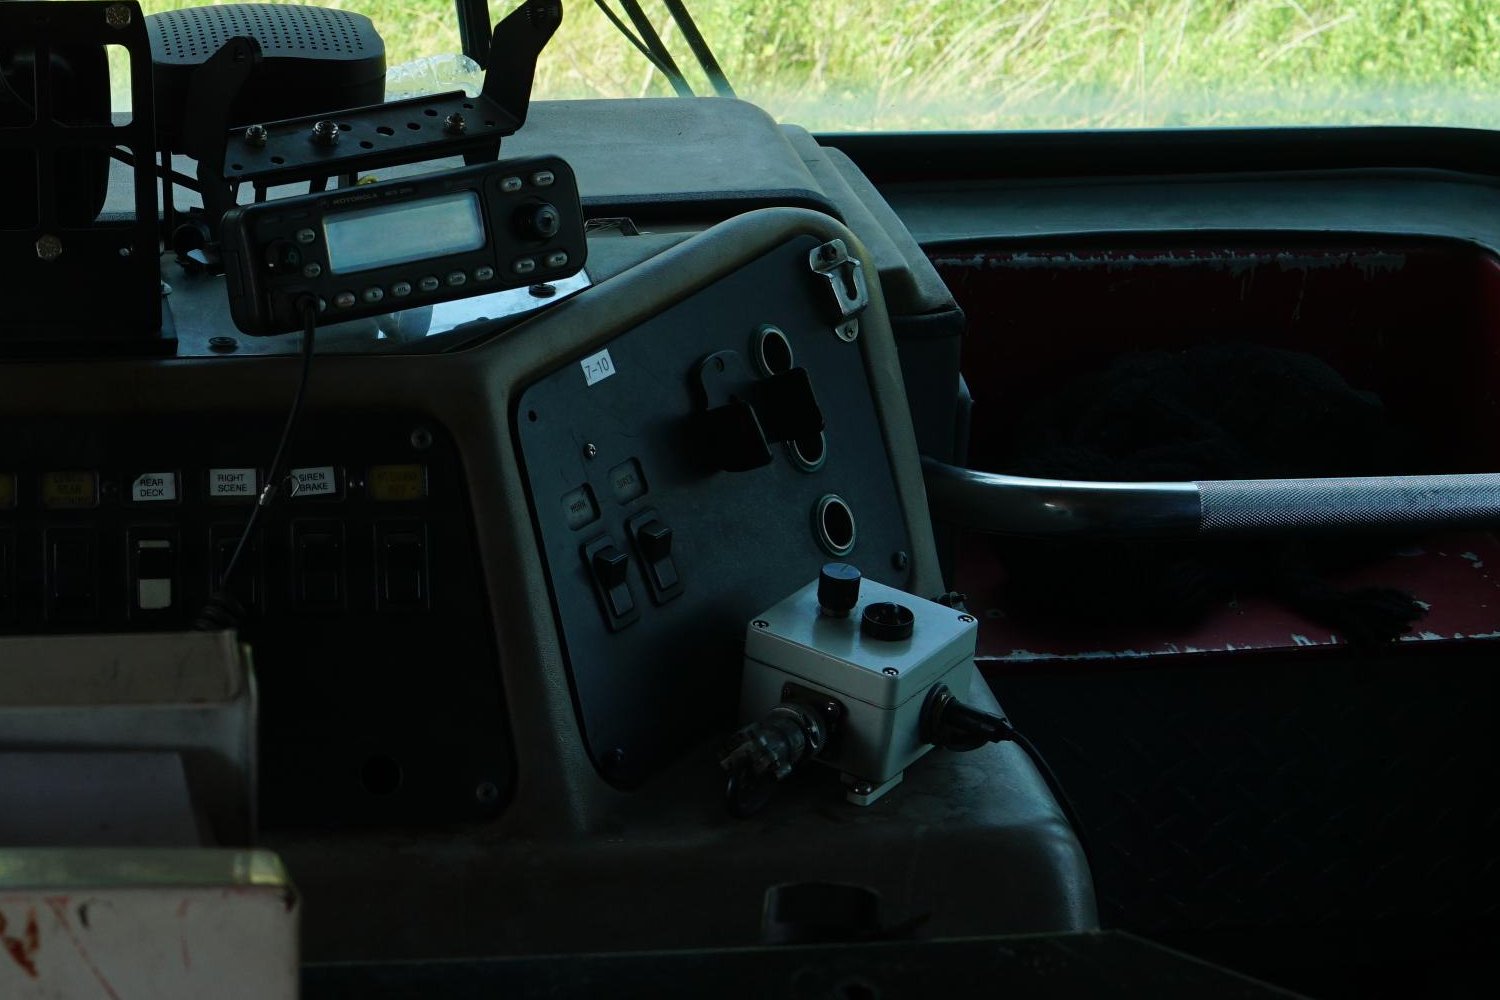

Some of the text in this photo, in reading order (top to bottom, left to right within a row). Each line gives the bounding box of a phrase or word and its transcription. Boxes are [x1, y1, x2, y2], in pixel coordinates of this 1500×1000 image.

[584, 356, 610, 380] 7-10
[218, 474, 244, 482] RIGHT
[298, 472, 325, 482] SIREN
[140, 478, 164, 487] REAR
[300, 482, 328, 492] BRAKE
[140, 488, 164, 497] DECK
[218, 484, 248, 492] SCENE
